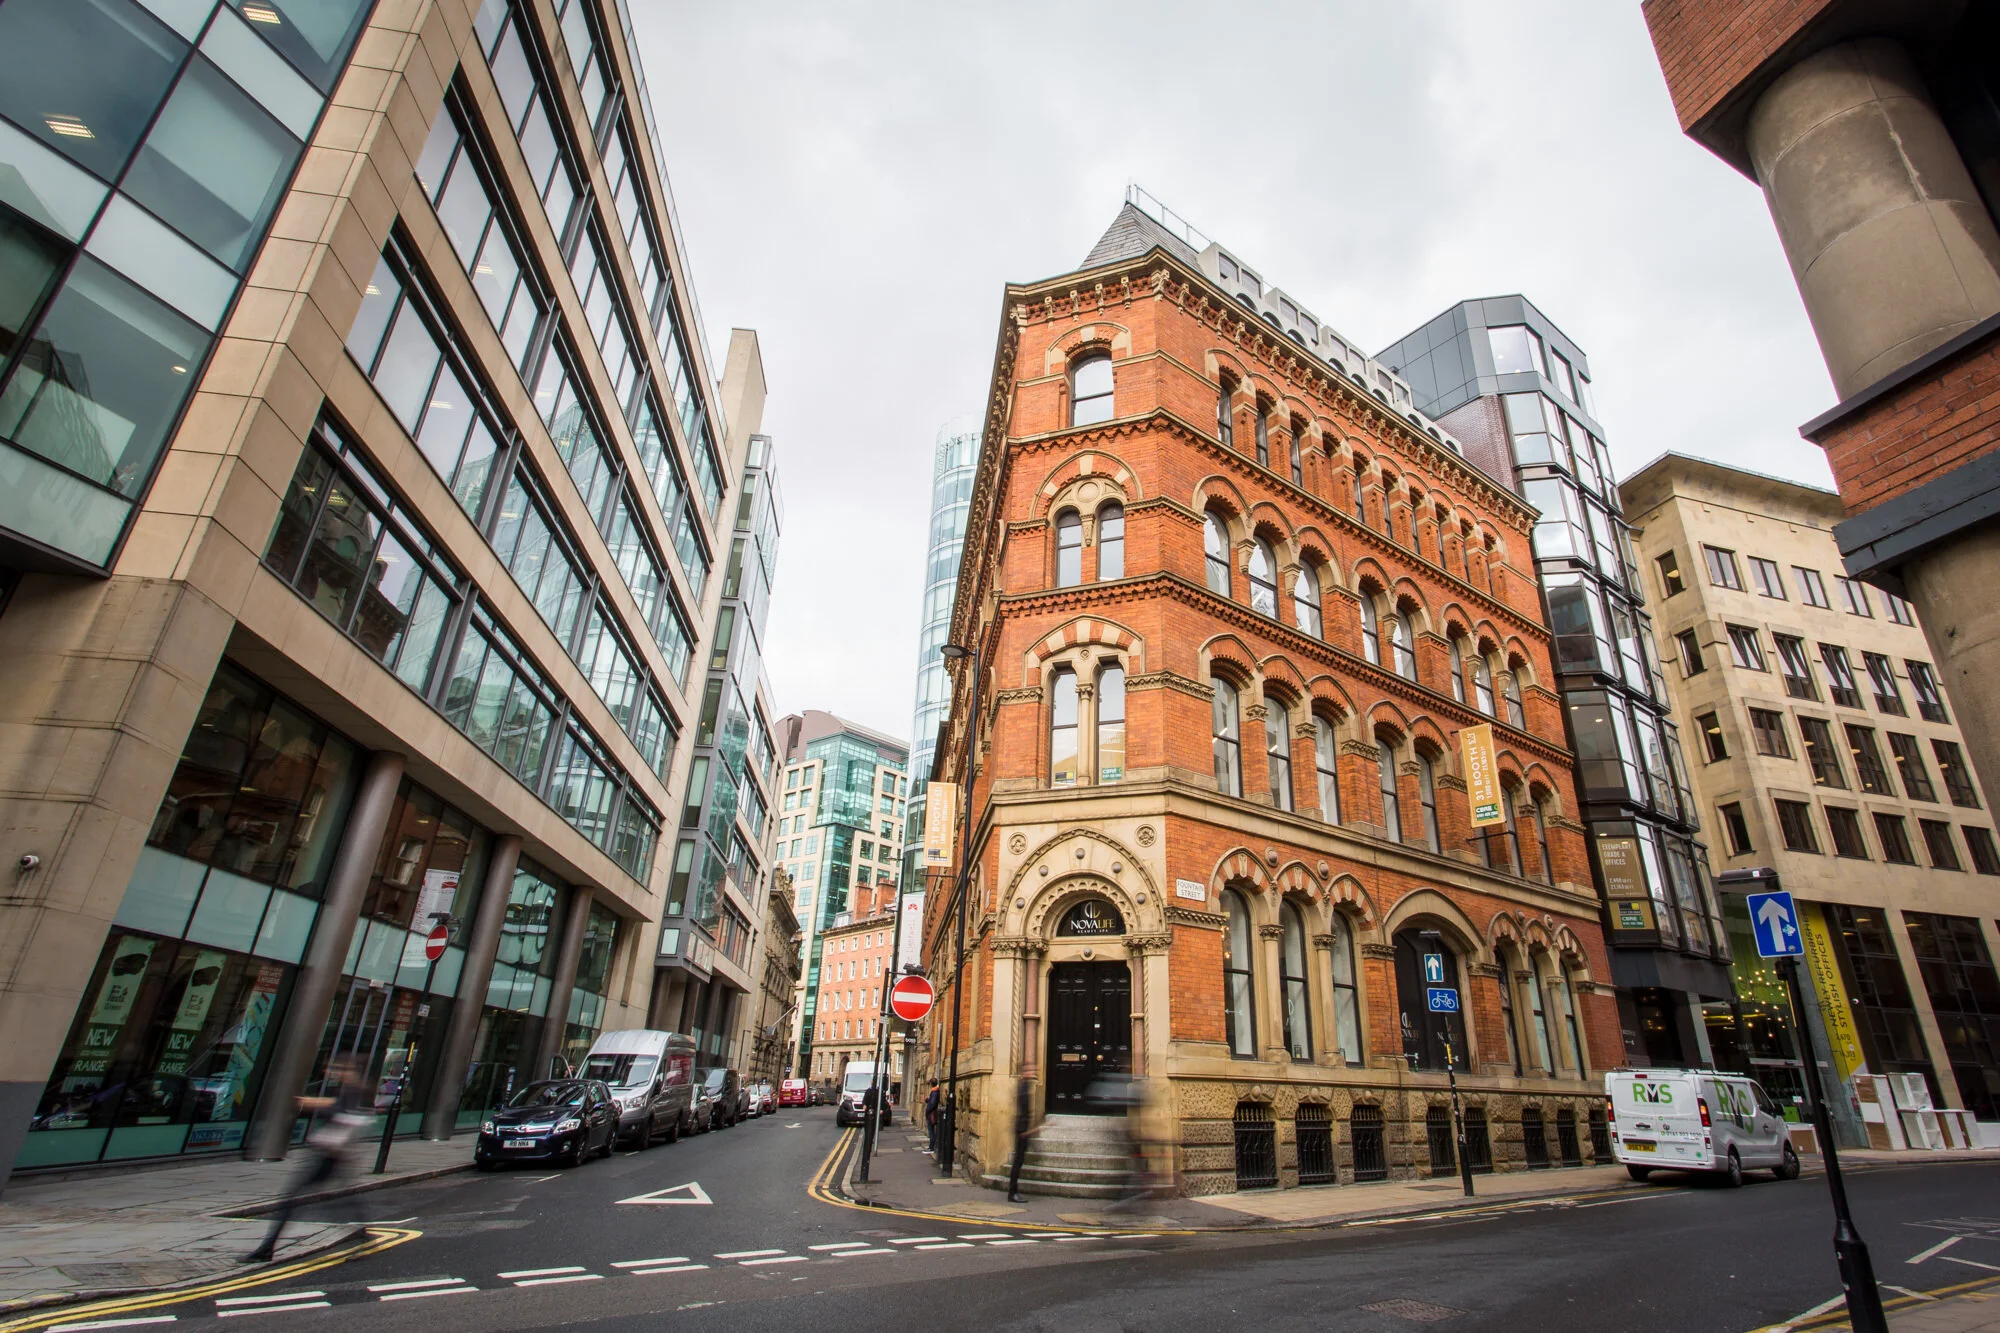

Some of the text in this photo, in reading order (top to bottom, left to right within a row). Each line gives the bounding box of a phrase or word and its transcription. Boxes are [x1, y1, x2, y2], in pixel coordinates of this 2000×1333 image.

[1470, 747, 1485, 801] 31 BOOTH
[932, 800, 941, 832] BOOTH
[1177, 880, 1204, 892] FOUNTAIN
[1181, 889, 1201, 899] STREET
[1071, 919, 1115, 930] NOVALIFE
[1815, 934, 1848, 1028] STYLISH OFFICES
[1820, 987, 1839, 1028] NEWLY
[84, 1028, 119, 1047] NEW
[168, 1033, 196, 1050] NEW
[74, 1060, 108, 1072] RANGE
[158, 1062, 187, 1074] RANGE
